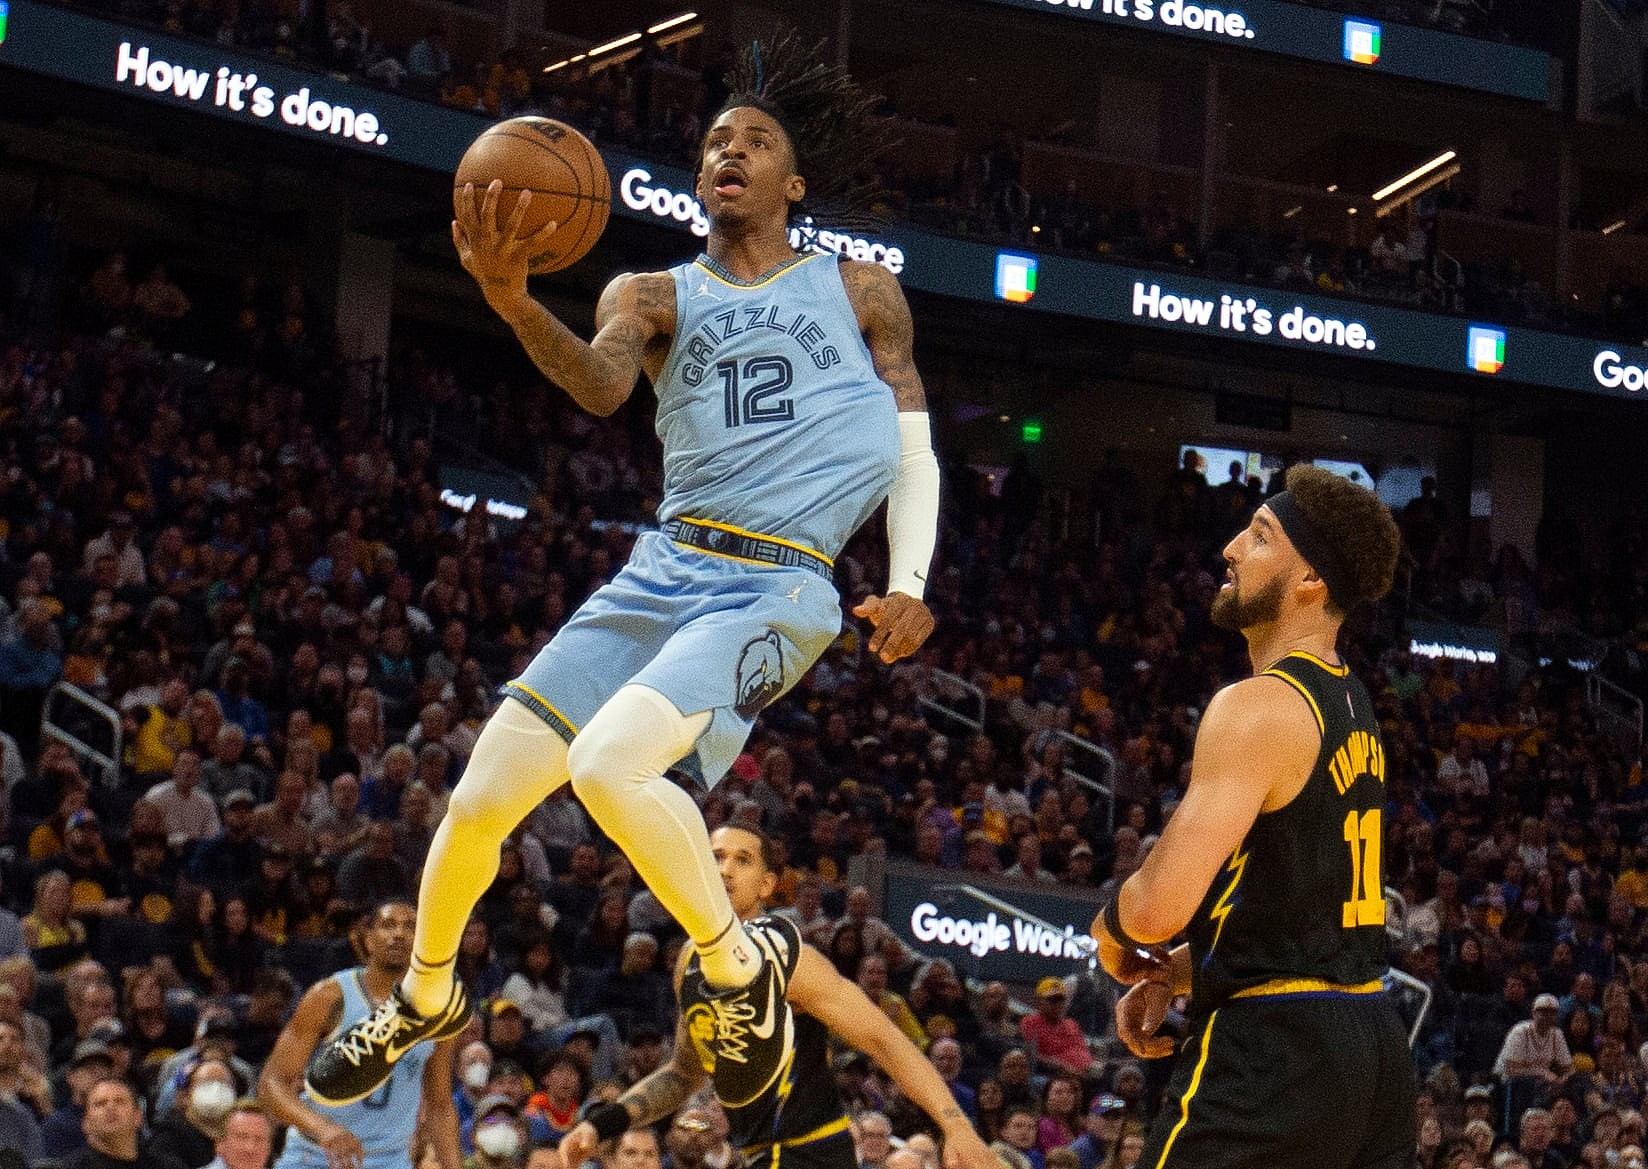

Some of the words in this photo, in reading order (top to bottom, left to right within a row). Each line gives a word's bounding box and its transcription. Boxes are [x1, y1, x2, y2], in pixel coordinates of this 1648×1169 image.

[1159, 0, 1255, 39] done.
[115, 42, 210, 100] How
[215, 66, 275, 118] it's
[281, 87, 388, 146] done.
[620, 168, 711, 237] Goog
[682, 305, 842, 387] GRIZZLIES
[1132, 282, 1214, 326] How
[1220, 294, 1273, 335] it's
[1278, 306, 1376, 351] done.
[716, 355, 795, 428] 12
[1342, 808, 1386, 928] 11
[911, 902, 1011, 957] Google
